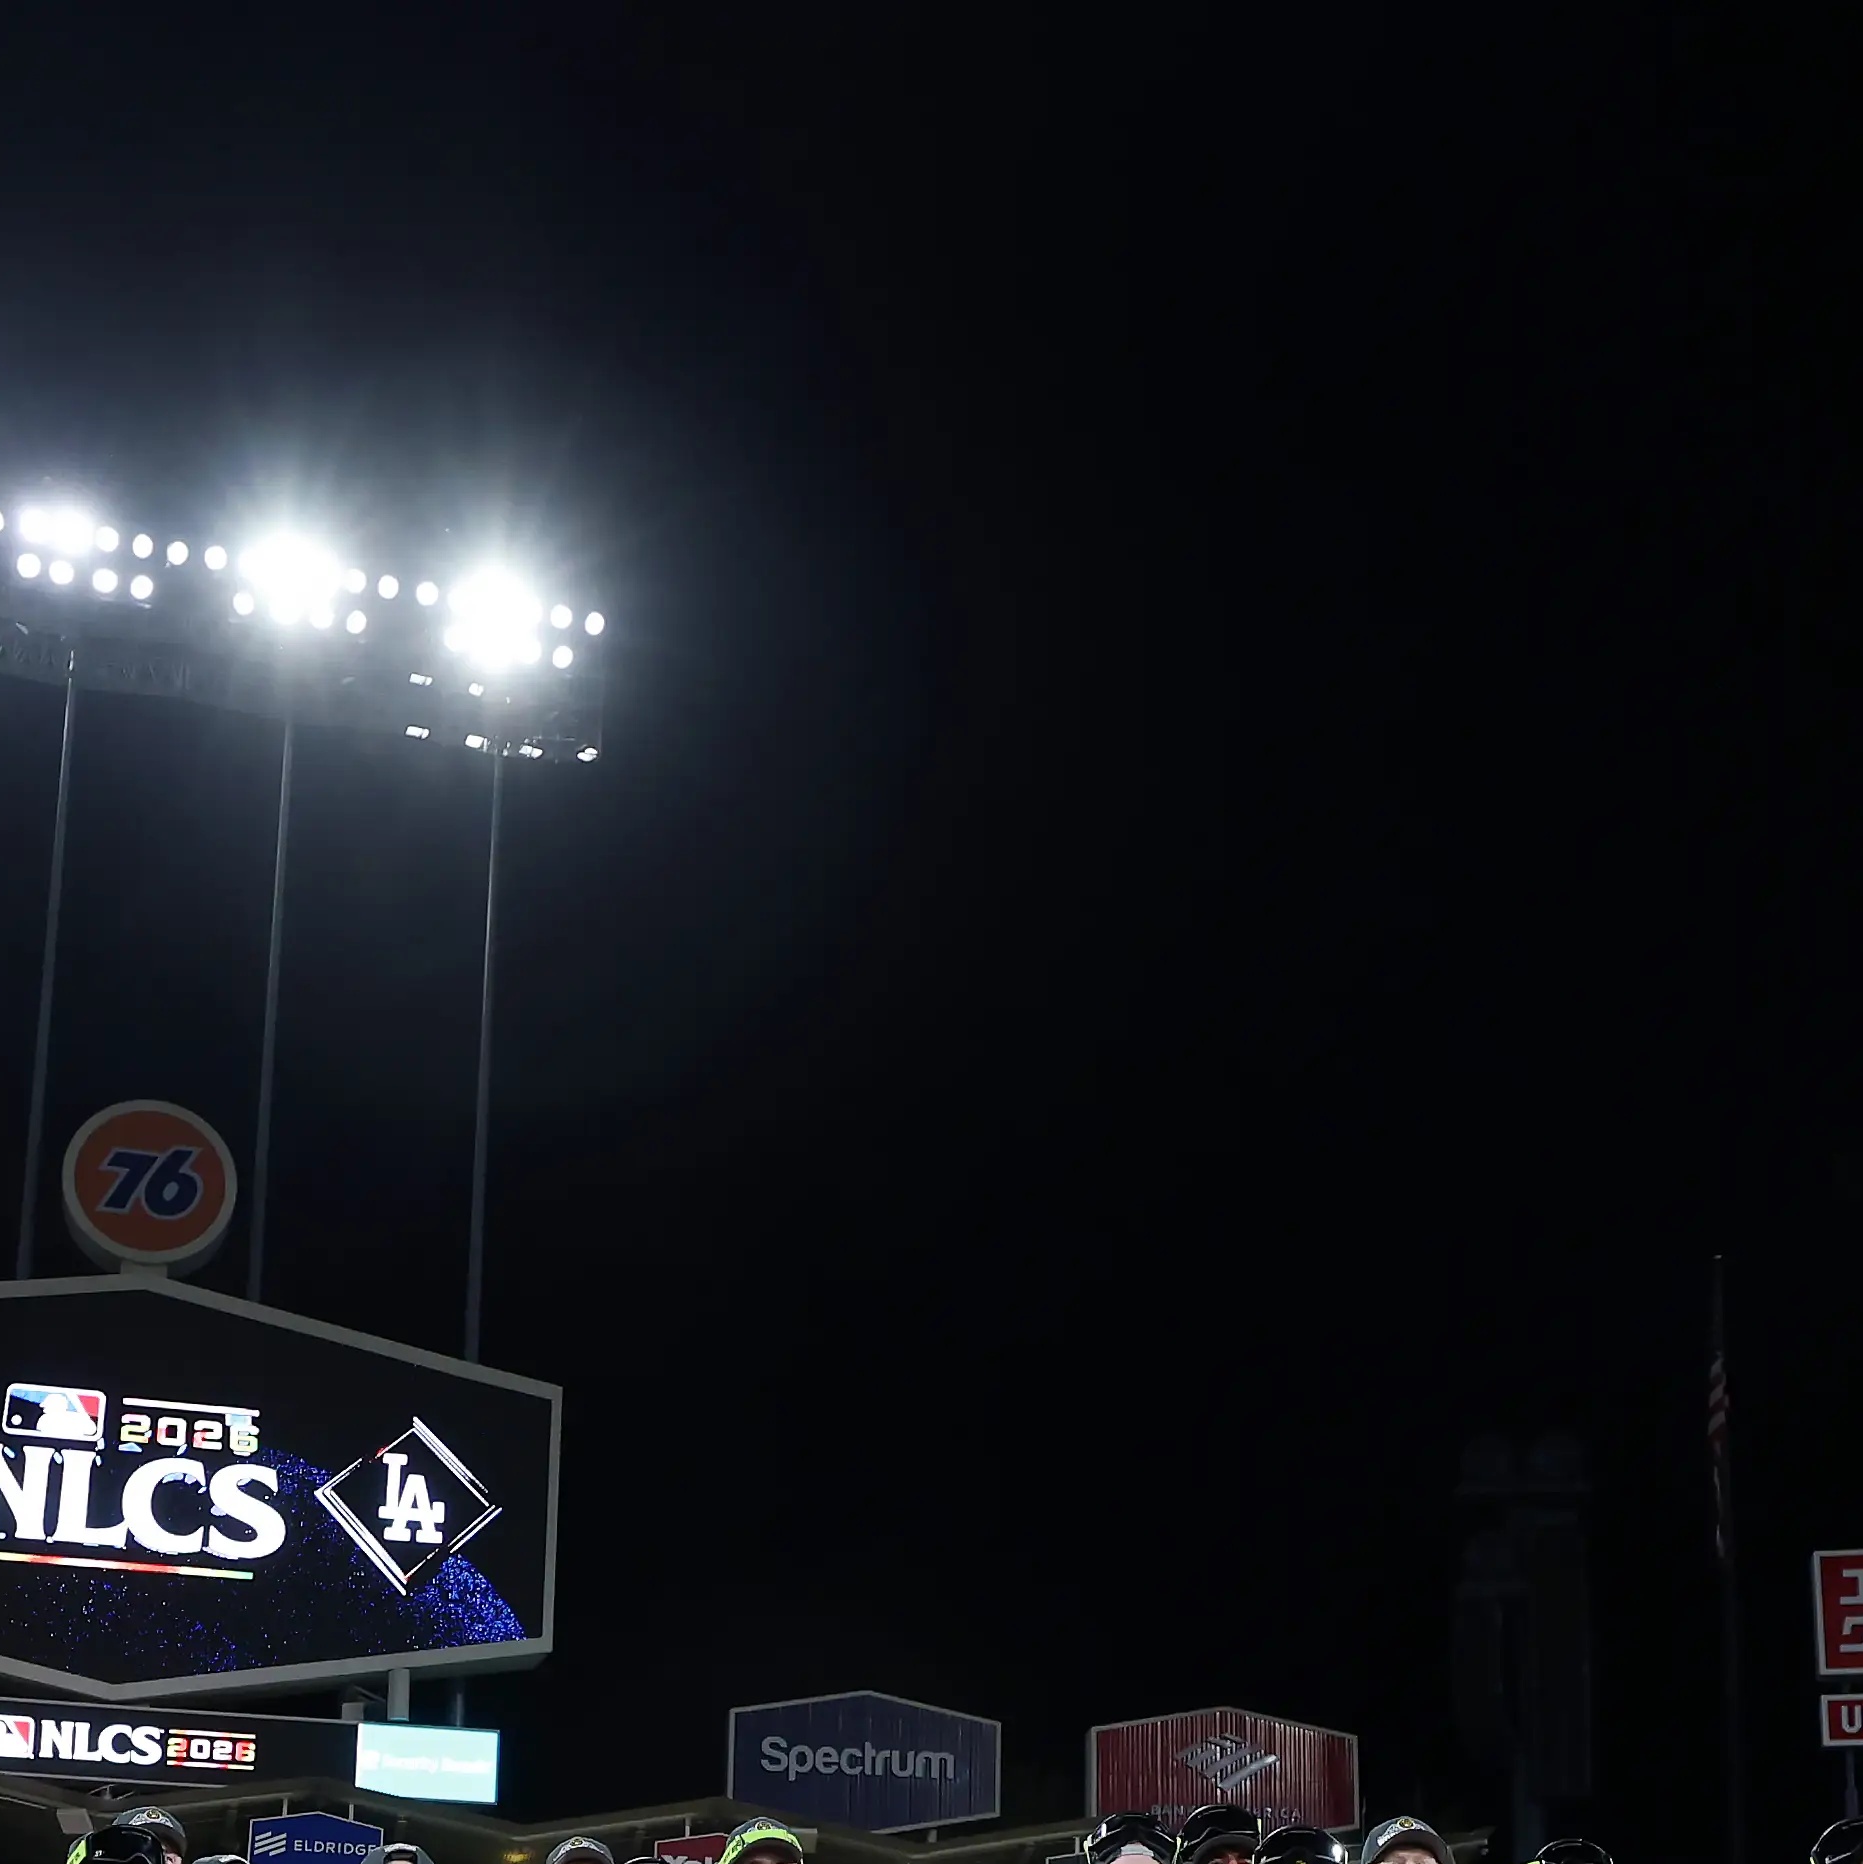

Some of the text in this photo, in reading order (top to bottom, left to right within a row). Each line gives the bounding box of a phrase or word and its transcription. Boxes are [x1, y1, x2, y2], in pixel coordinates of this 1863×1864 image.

[95, 1145, 205, 1220] 76
[119, 1412, 259, 1454] 2026
[377, 1452, 445, 1546] LA
[39, 1721, 256, 1766] NLCS 2026
[760, 1736, 955, 1781] Spectrum
